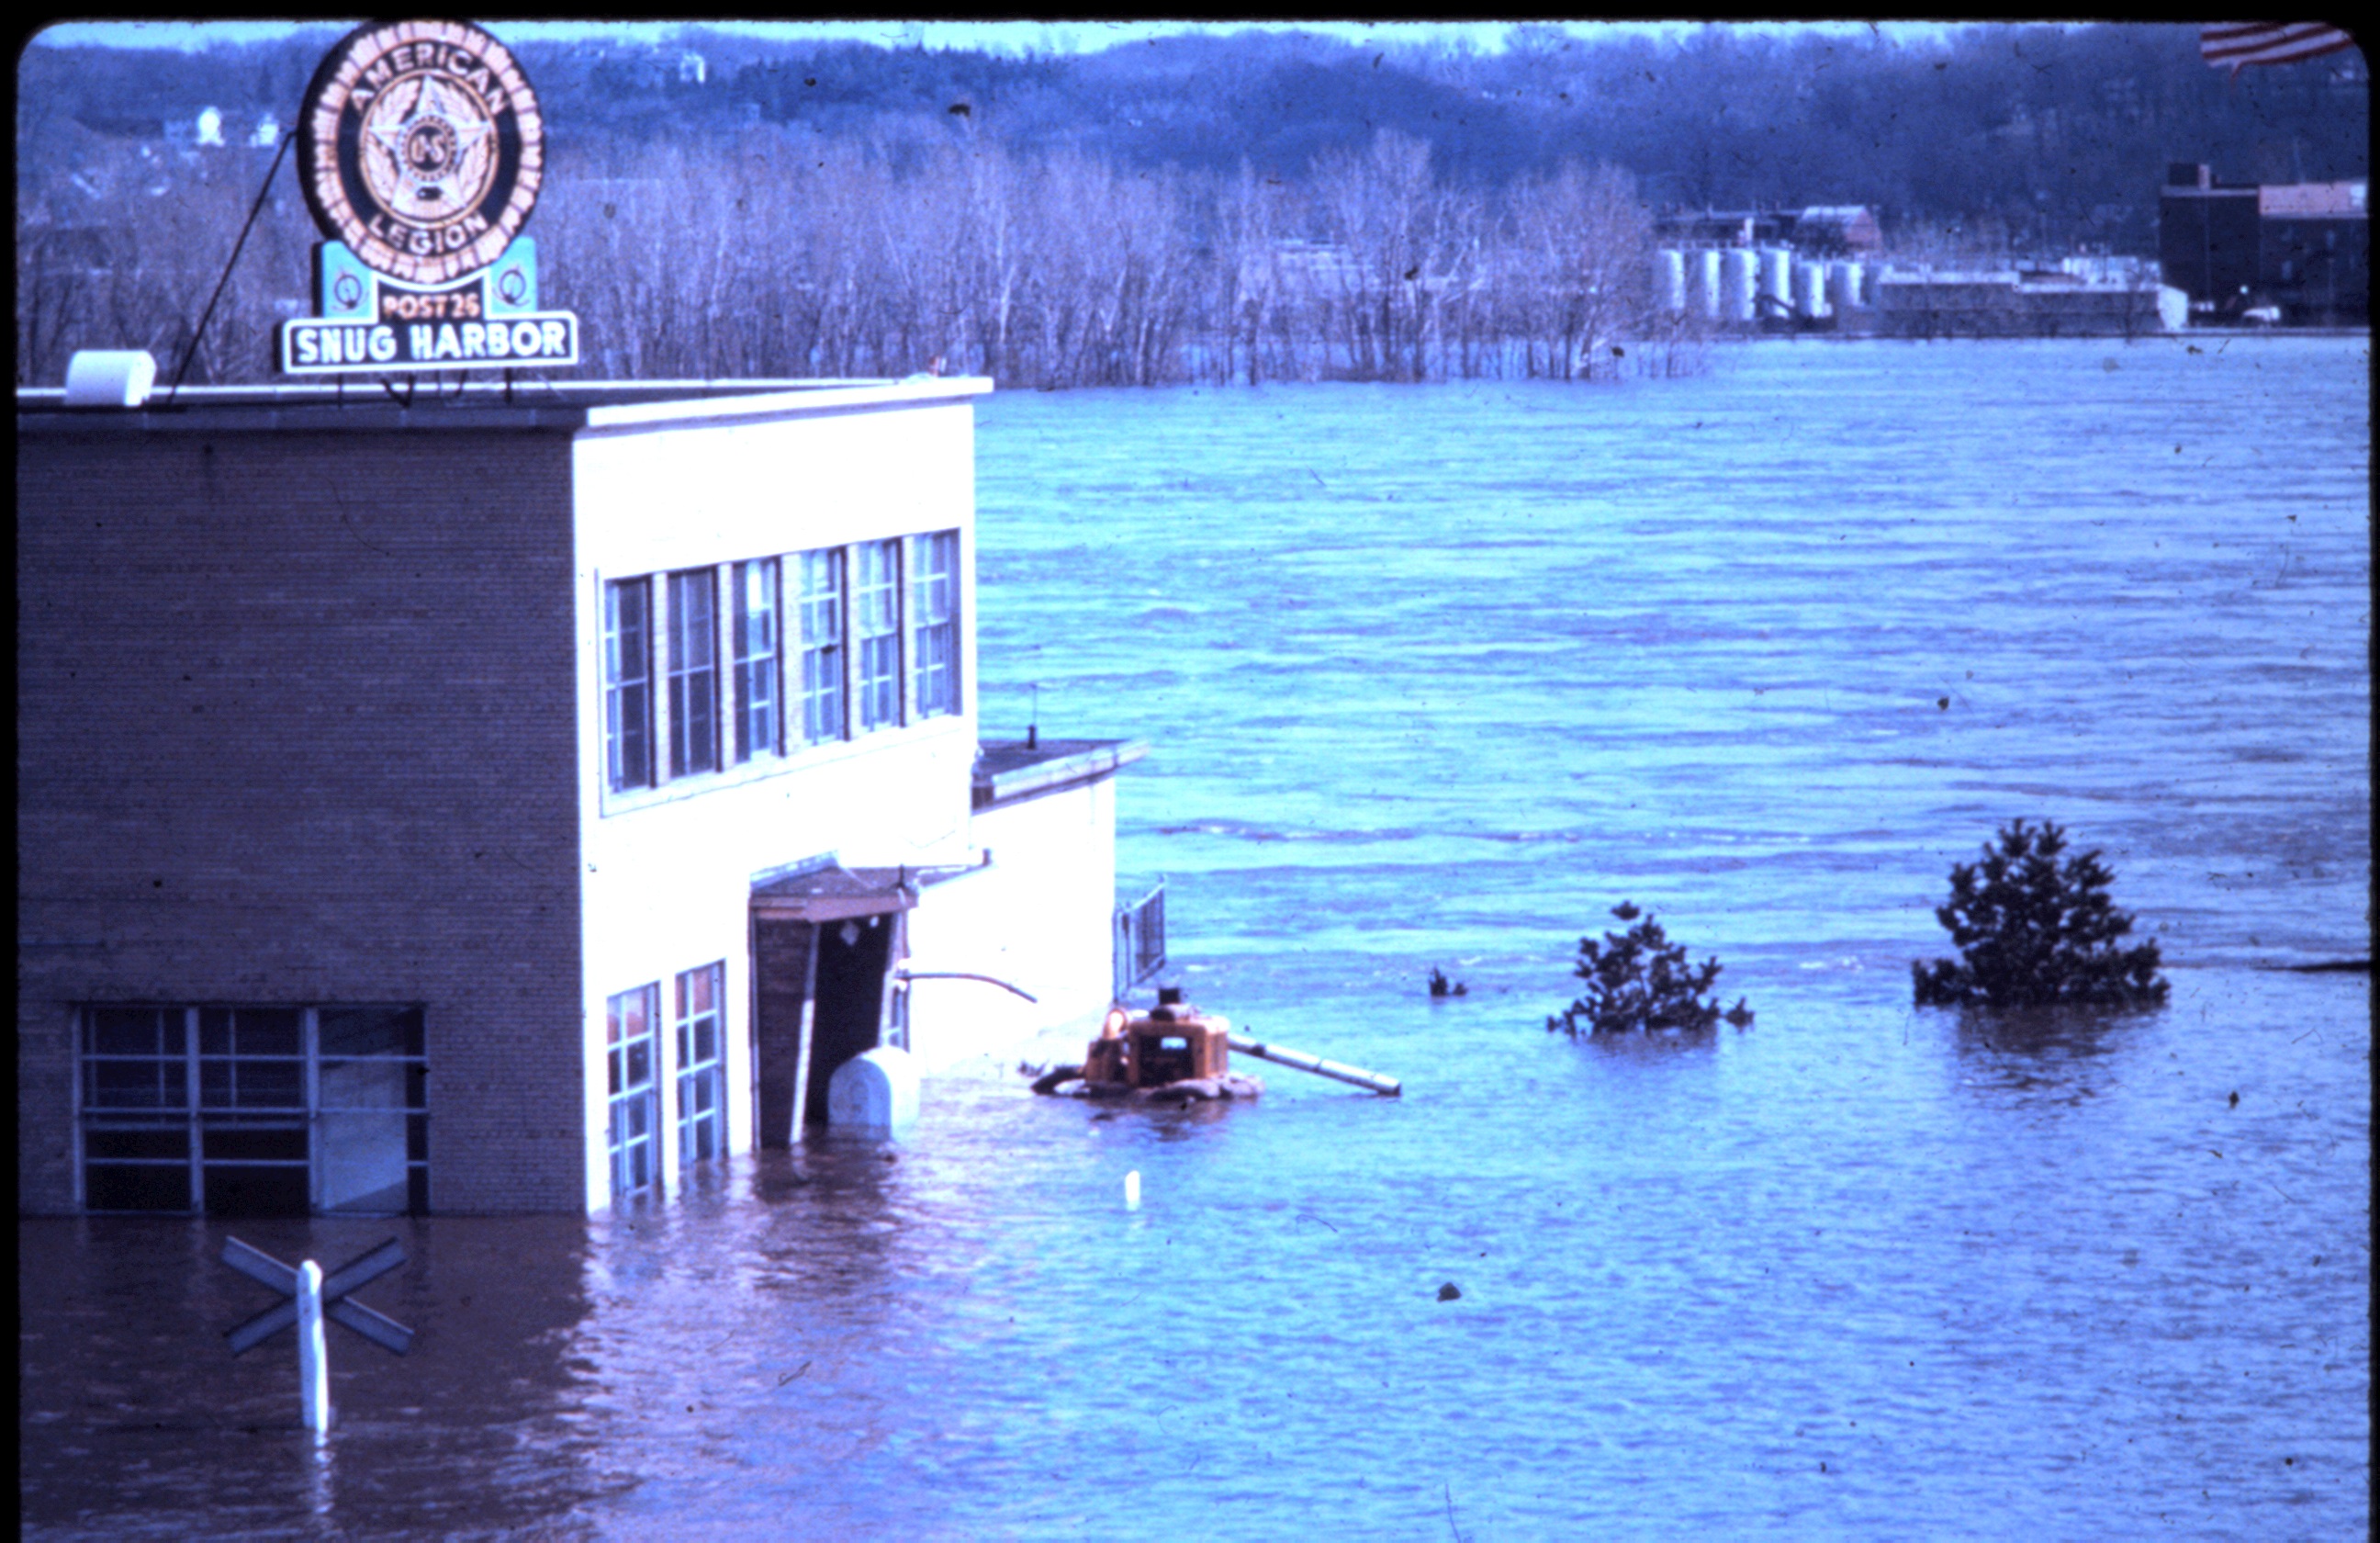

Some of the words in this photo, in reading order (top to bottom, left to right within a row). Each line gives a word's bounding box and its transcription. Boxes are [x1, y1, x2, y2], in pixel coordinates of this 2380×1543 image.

[352, 43, 511, 115] AMERICAN
[368, 213, 488, 254] LEGION
[383, 295, 446, 319] POST
[449, 293, 481, 317] 26
[297, 326, 397, 363] SNUG
[410, 321, 566, 359] HARBOR
